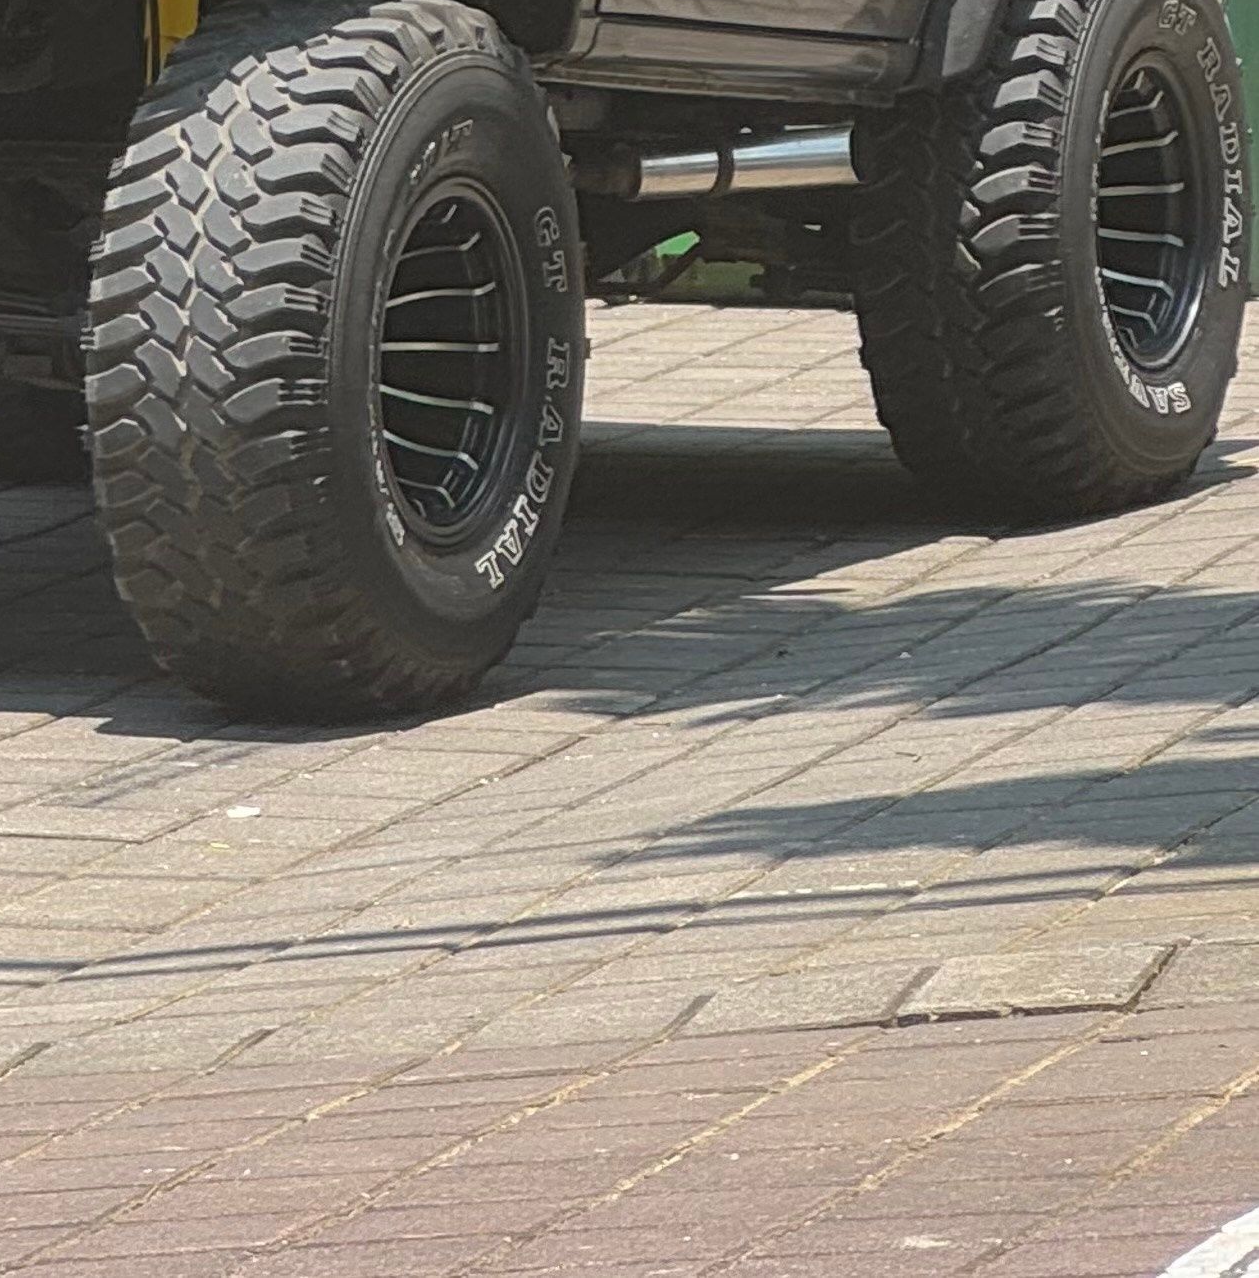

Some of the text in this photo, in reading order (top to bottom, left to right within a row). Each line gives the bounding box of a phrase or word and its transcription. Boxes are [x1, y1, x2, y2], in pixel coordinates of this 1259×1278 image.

[1197, 37, 1243, 290] RADIAL
[474, 205, 570, 589] GT RADIAL
